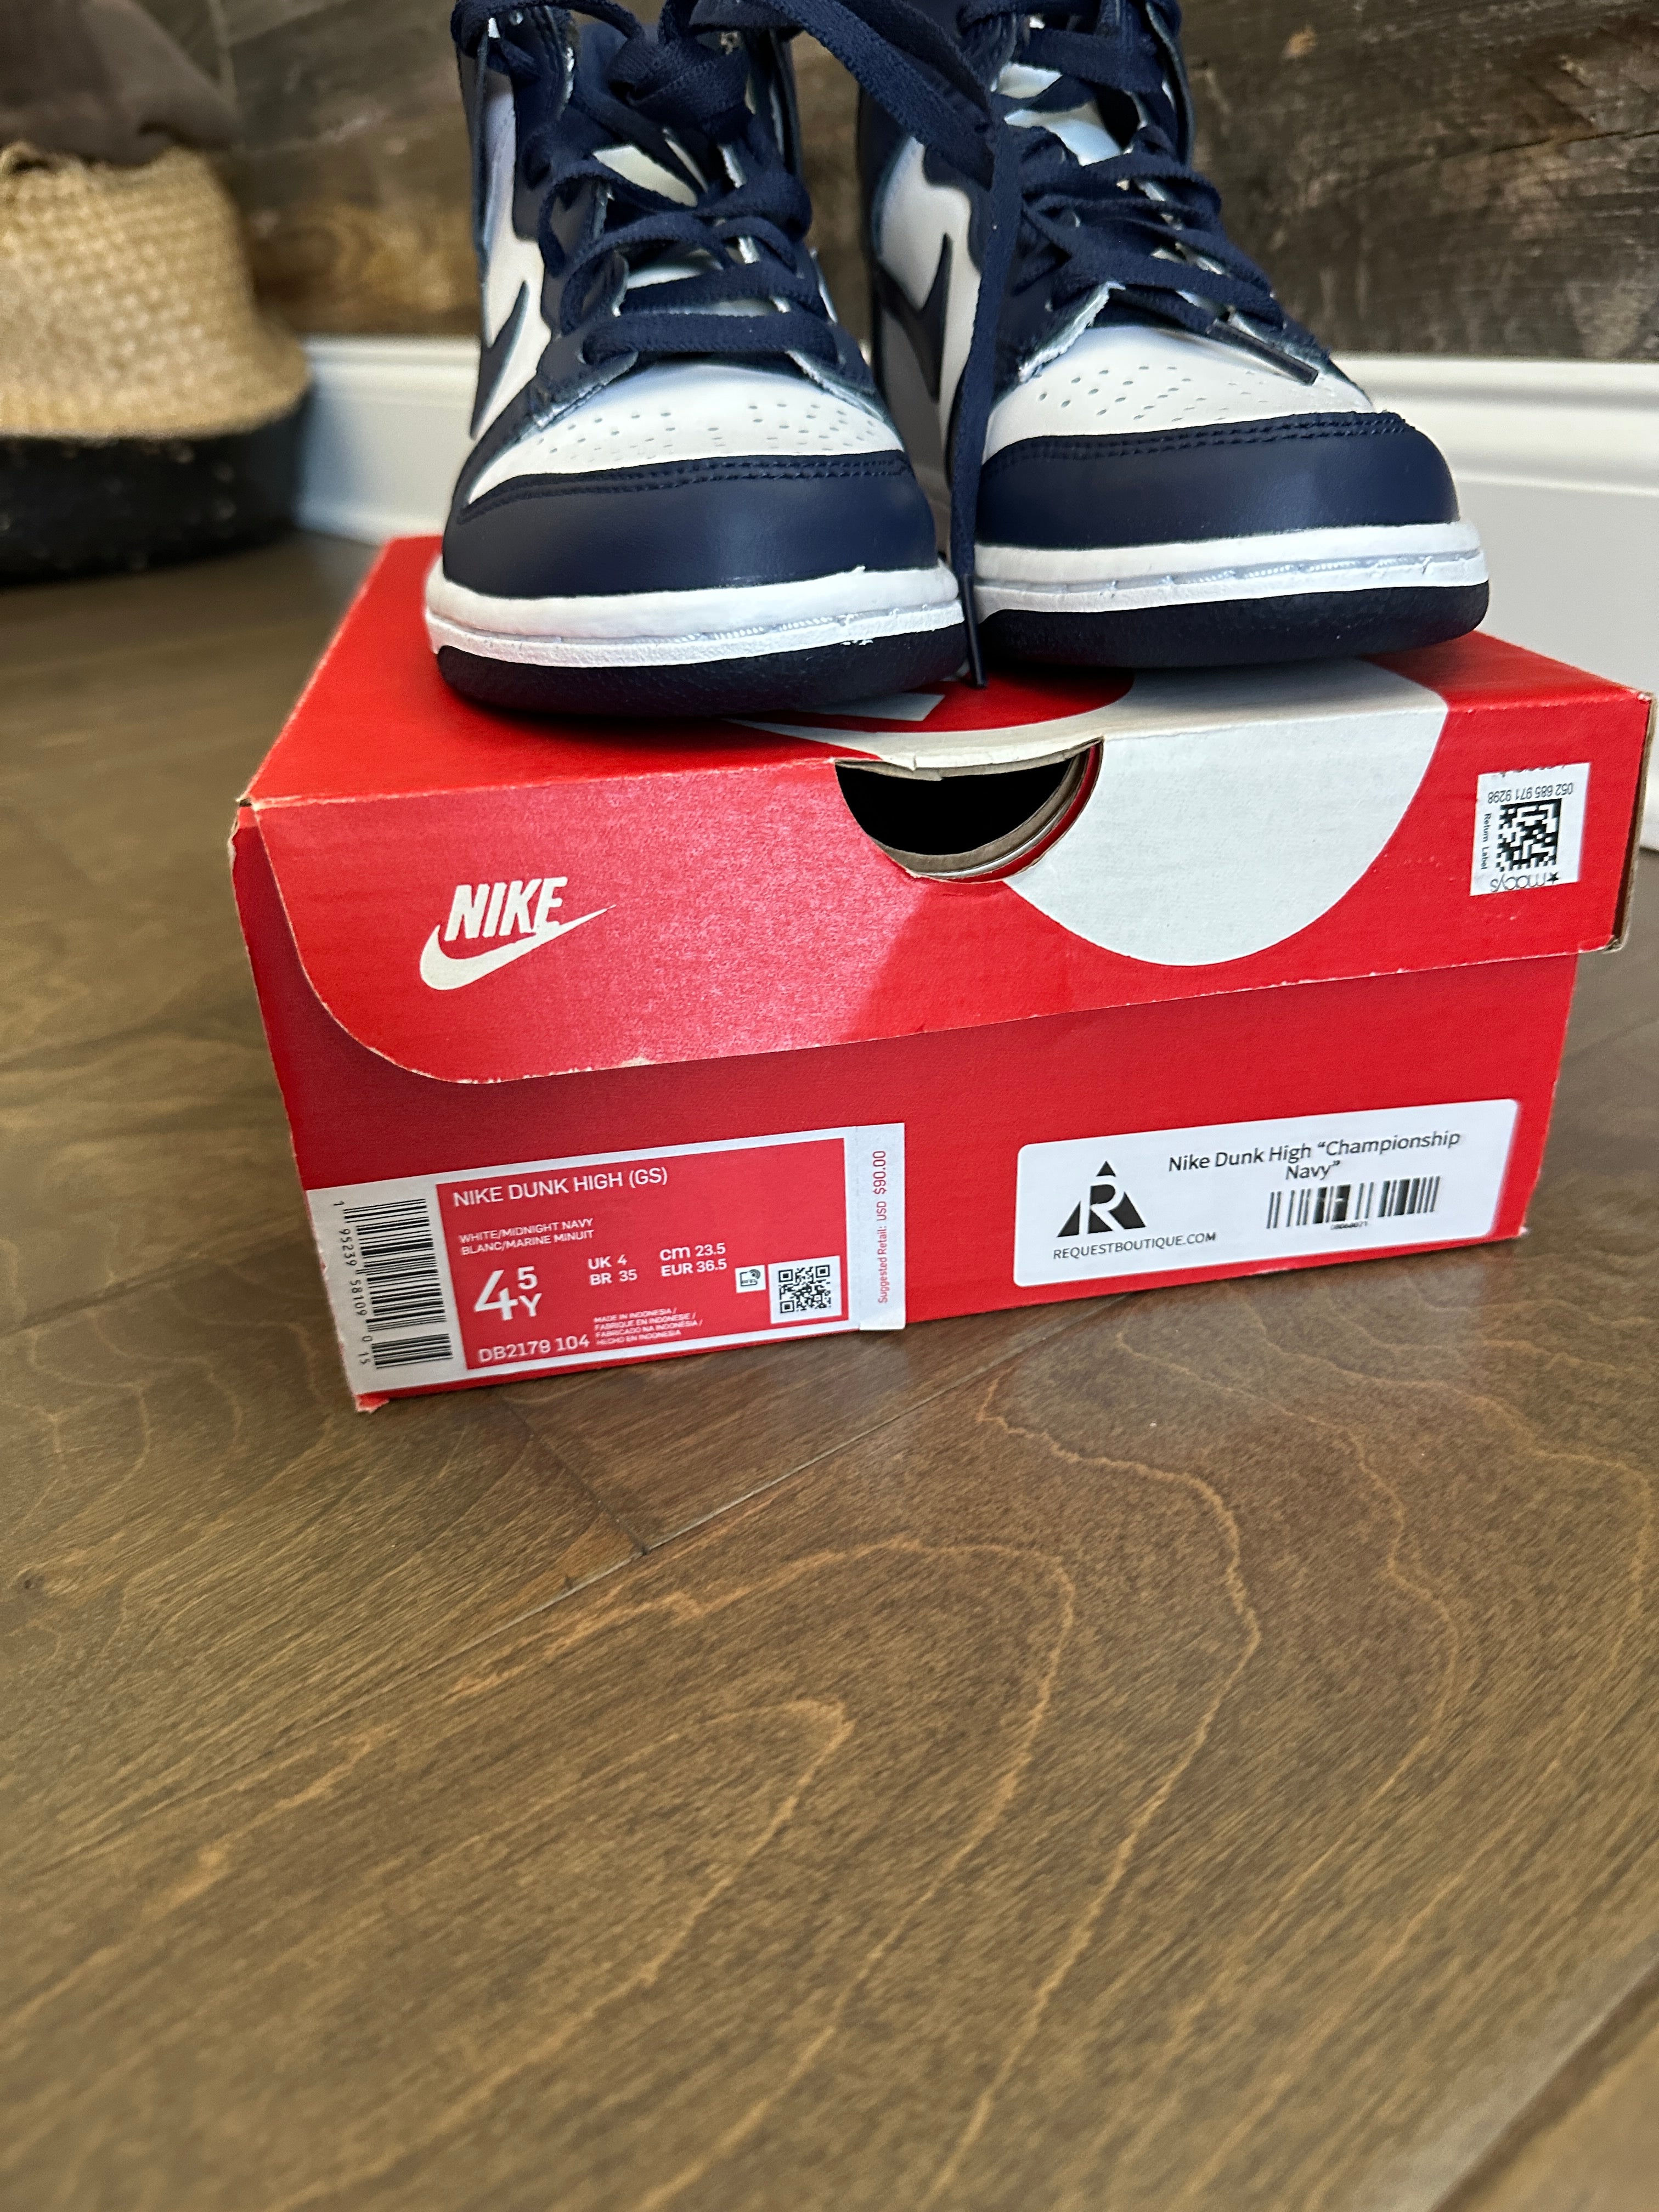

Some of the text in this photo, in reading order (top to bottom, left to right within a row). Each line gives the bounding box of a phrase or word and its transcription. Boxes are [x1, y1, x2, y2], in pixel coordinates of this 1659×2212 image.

[1487, 782, 1574, 803] 052 685 971 9298
[1481, 812, 1492, 870] Return Label
[444, 876, 567, 941] NIKE
[1169, 1154, 1210, 1172] Nike
[1215, 1148, 1265, 1167] Dunk
[1268, 1143, 1311, 1164] High
[453, 1166, 668, 1207] NIKE DUNK HIGH (GS)
[459, 1218, 594, 1244] WHITE/MIDNIGHT NAVY
[872, 1150, 889, 1304] Suggested Retail: USD $90.00
[339, 1228, 357, 1266] 95239
[460, 1229, 595, 1256] BLANC/MARINE MINUIT
[659, 1243, 726, 1261] cm 23.5
[1053, 1232, 1216, 1259] REQUESTBOUTIQUE.COM
[588, 1254, 628, 1269] UK 4
[661, 1258, 727, 1277] EUR 36.5
[590, 1269, 637, 1285] BR 35
[350, 1279, 368, 1316] 58109
[474, 1266, 542, 1321] 4 5 Y
[358, 1351, 370, 1365] 15
[478, 1334, 590, 1362] DB2179 104
